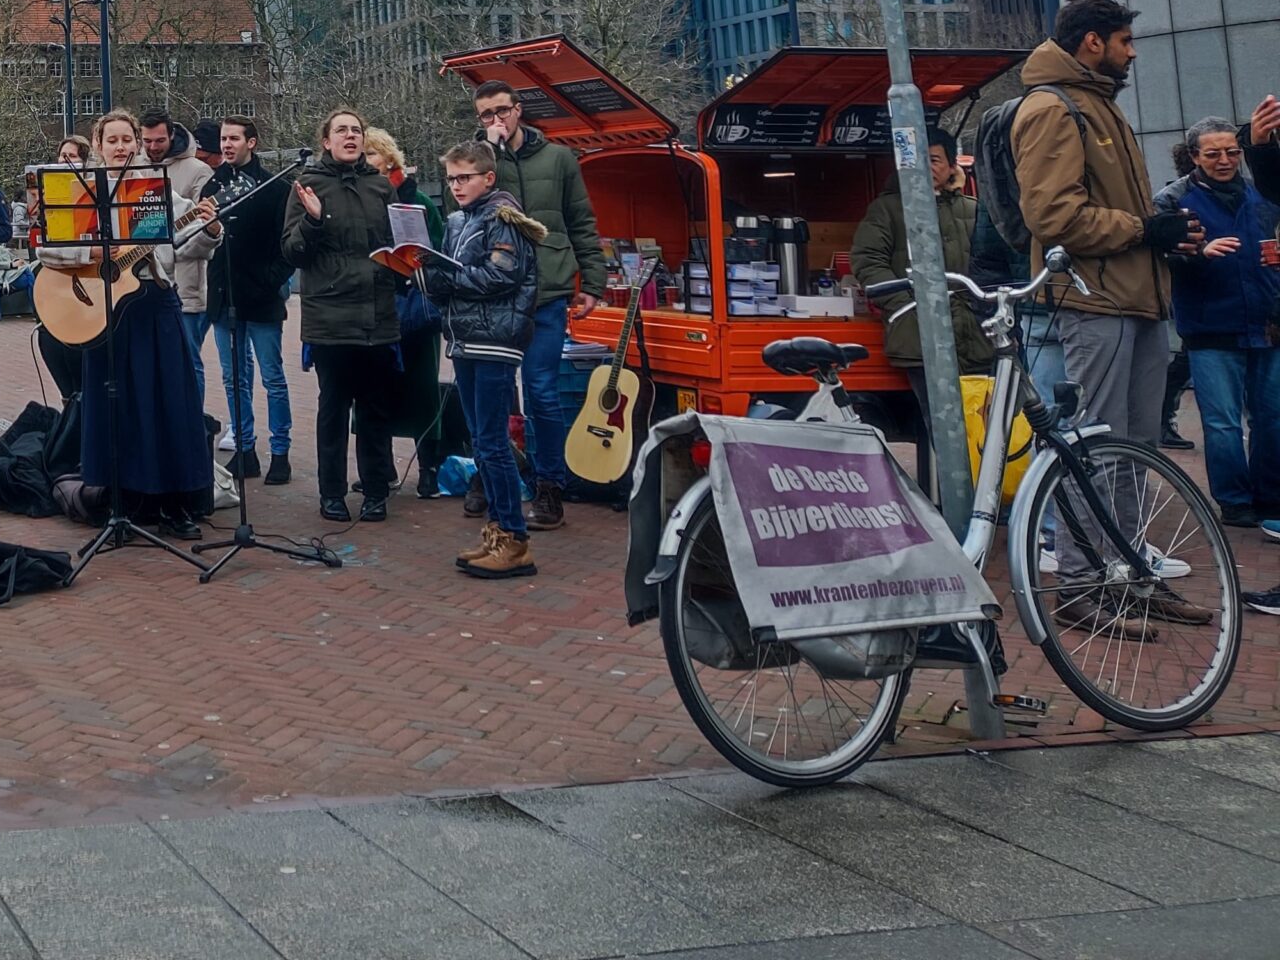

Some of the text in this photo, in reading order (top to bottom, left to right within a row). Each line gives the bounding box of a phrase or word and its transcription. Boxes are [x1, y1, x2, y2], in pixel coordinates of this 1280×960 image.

[768, 463, 870, 494] de Beste
[749, 500, 917, 541] Bijverdienste
[770, 573, 967, 608] www.krantenbezorgen.nl
